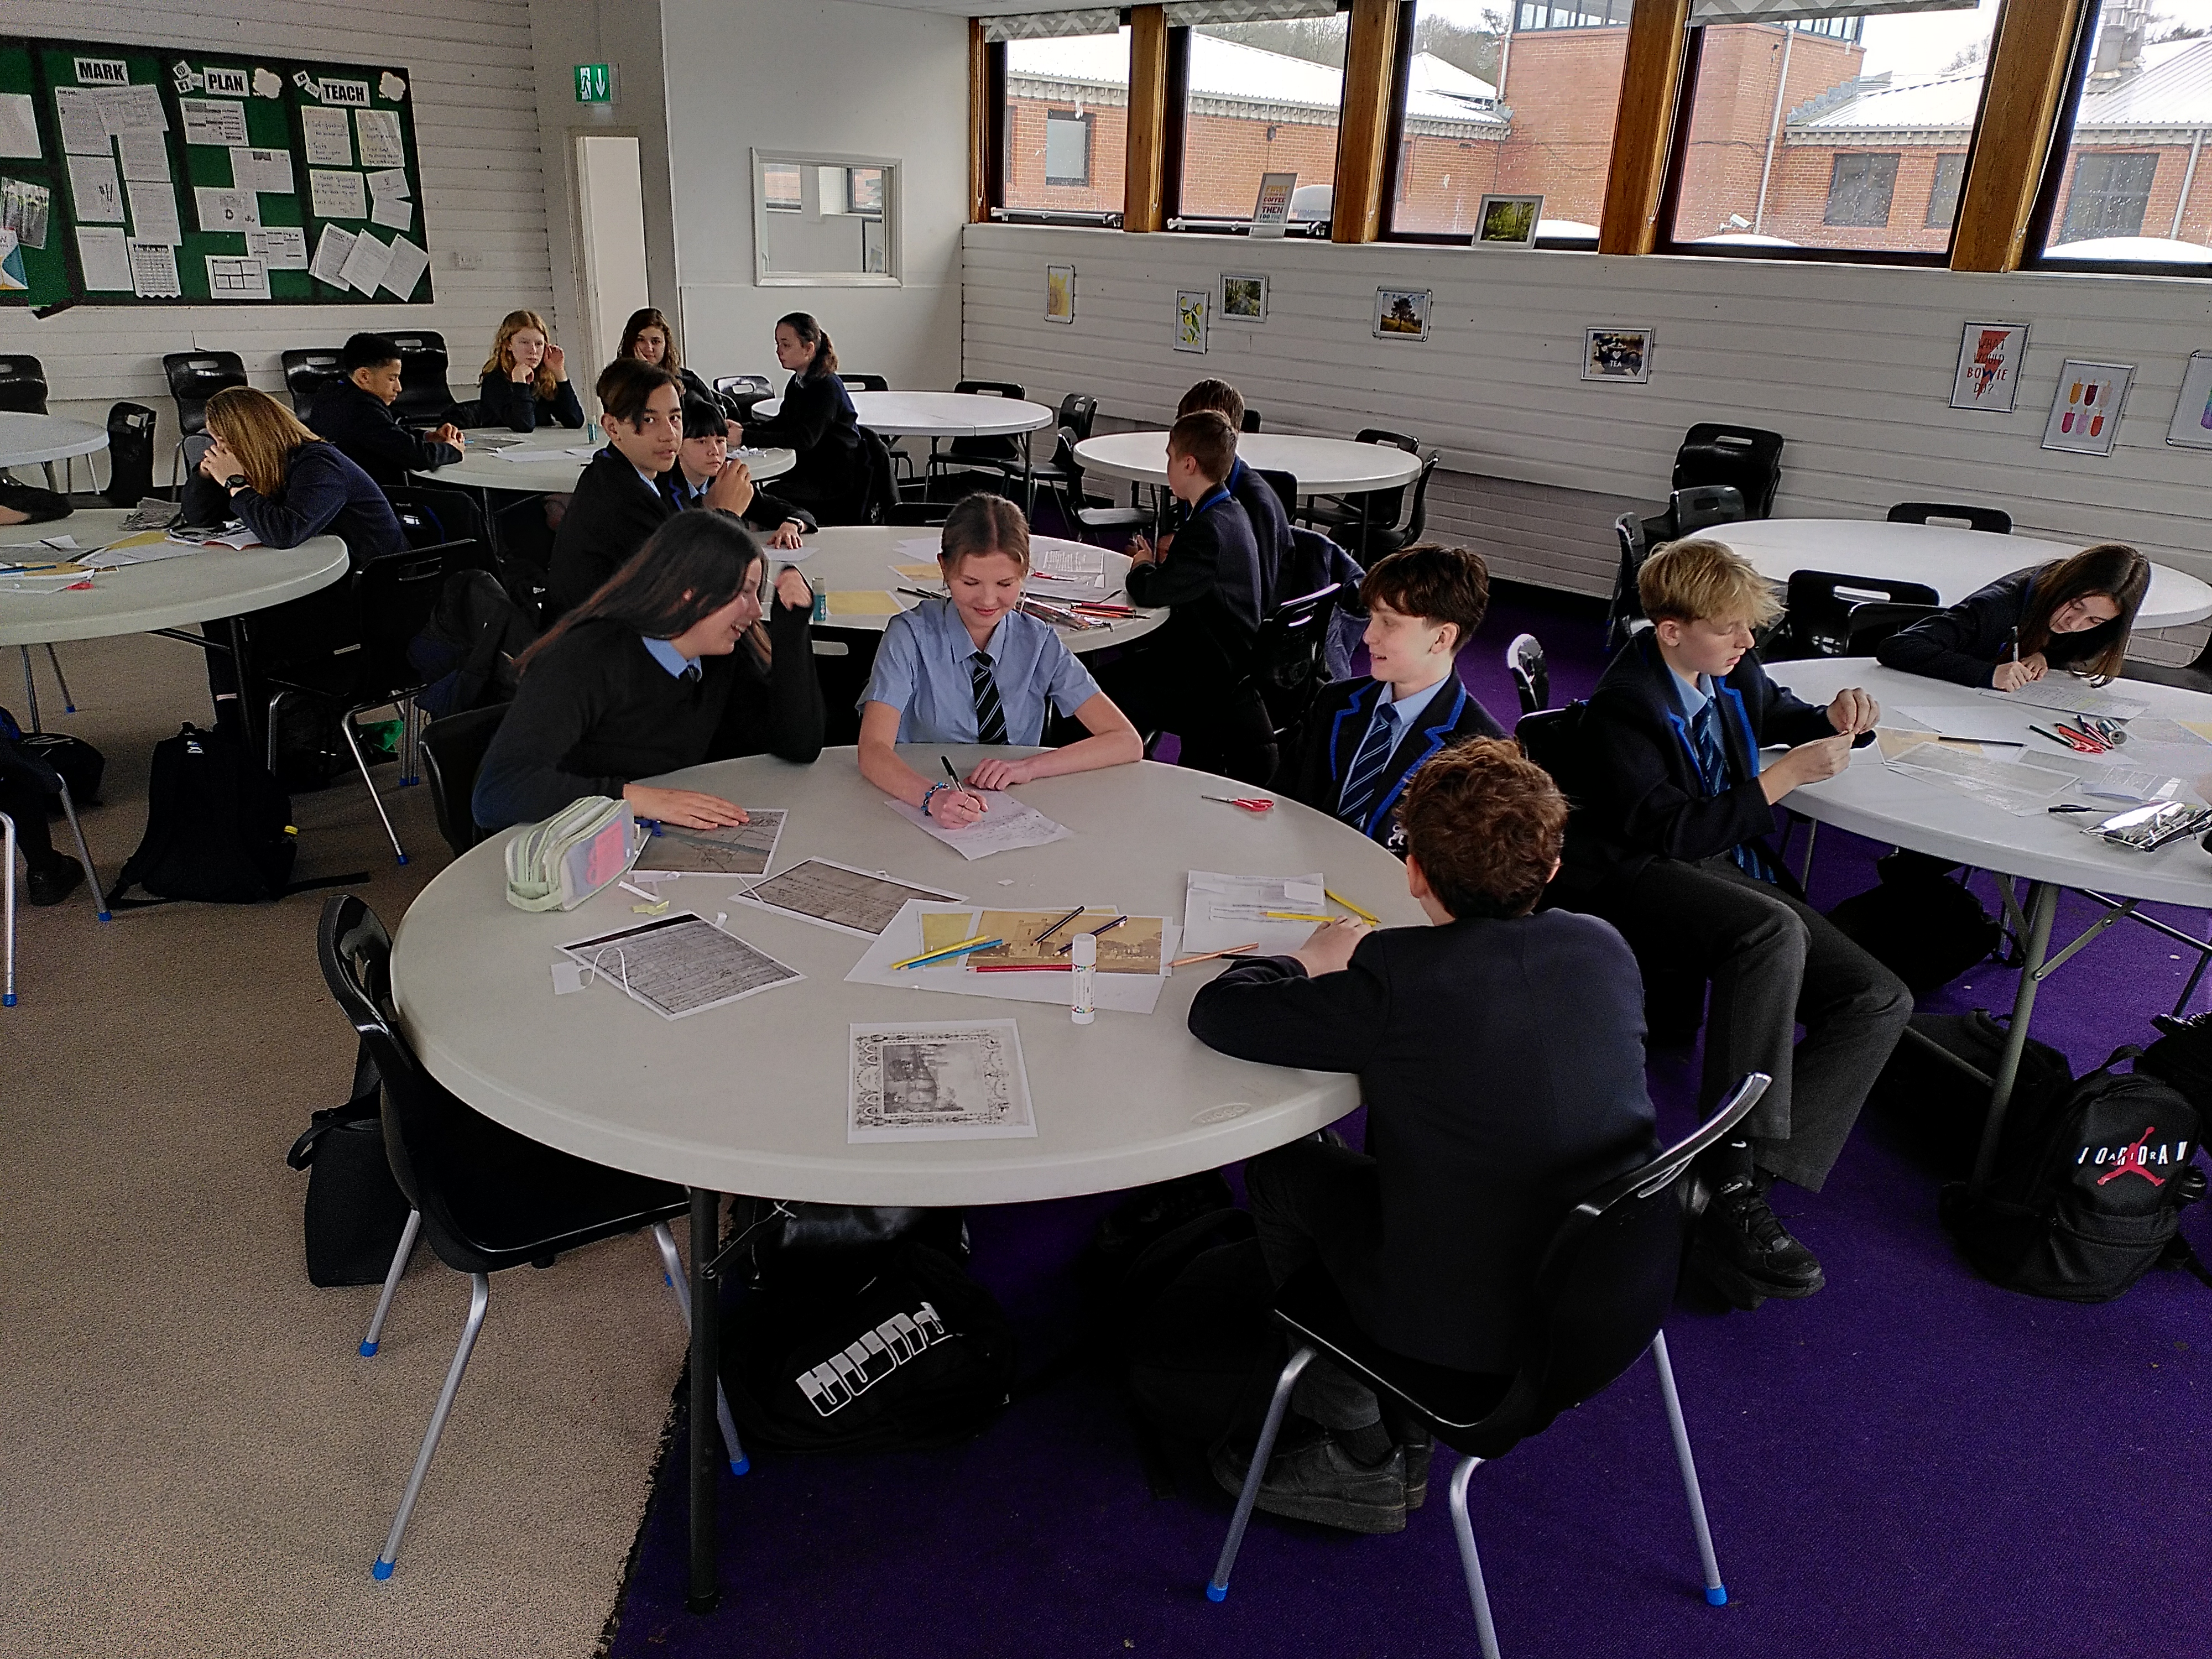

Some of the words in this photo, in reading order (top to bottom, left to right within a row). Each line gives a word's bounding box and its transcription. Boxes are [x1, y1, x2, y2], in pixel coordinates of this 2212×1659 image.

[79, 62, 125, 81] MARK
[208, 74, 244, 91] PLAN
[323, 84, 365, 102] TEACH
[1261, 206, 1284, 214] THEN
[1978, 338, 2005, 350] WHAT
[1974, 353, 2005, 365] WOULD
[1966, 367, 2008, 383] BOWIE
[1974, 382, 1994, 394] DO?
[795, 1301, 954, 1417] PUMA
